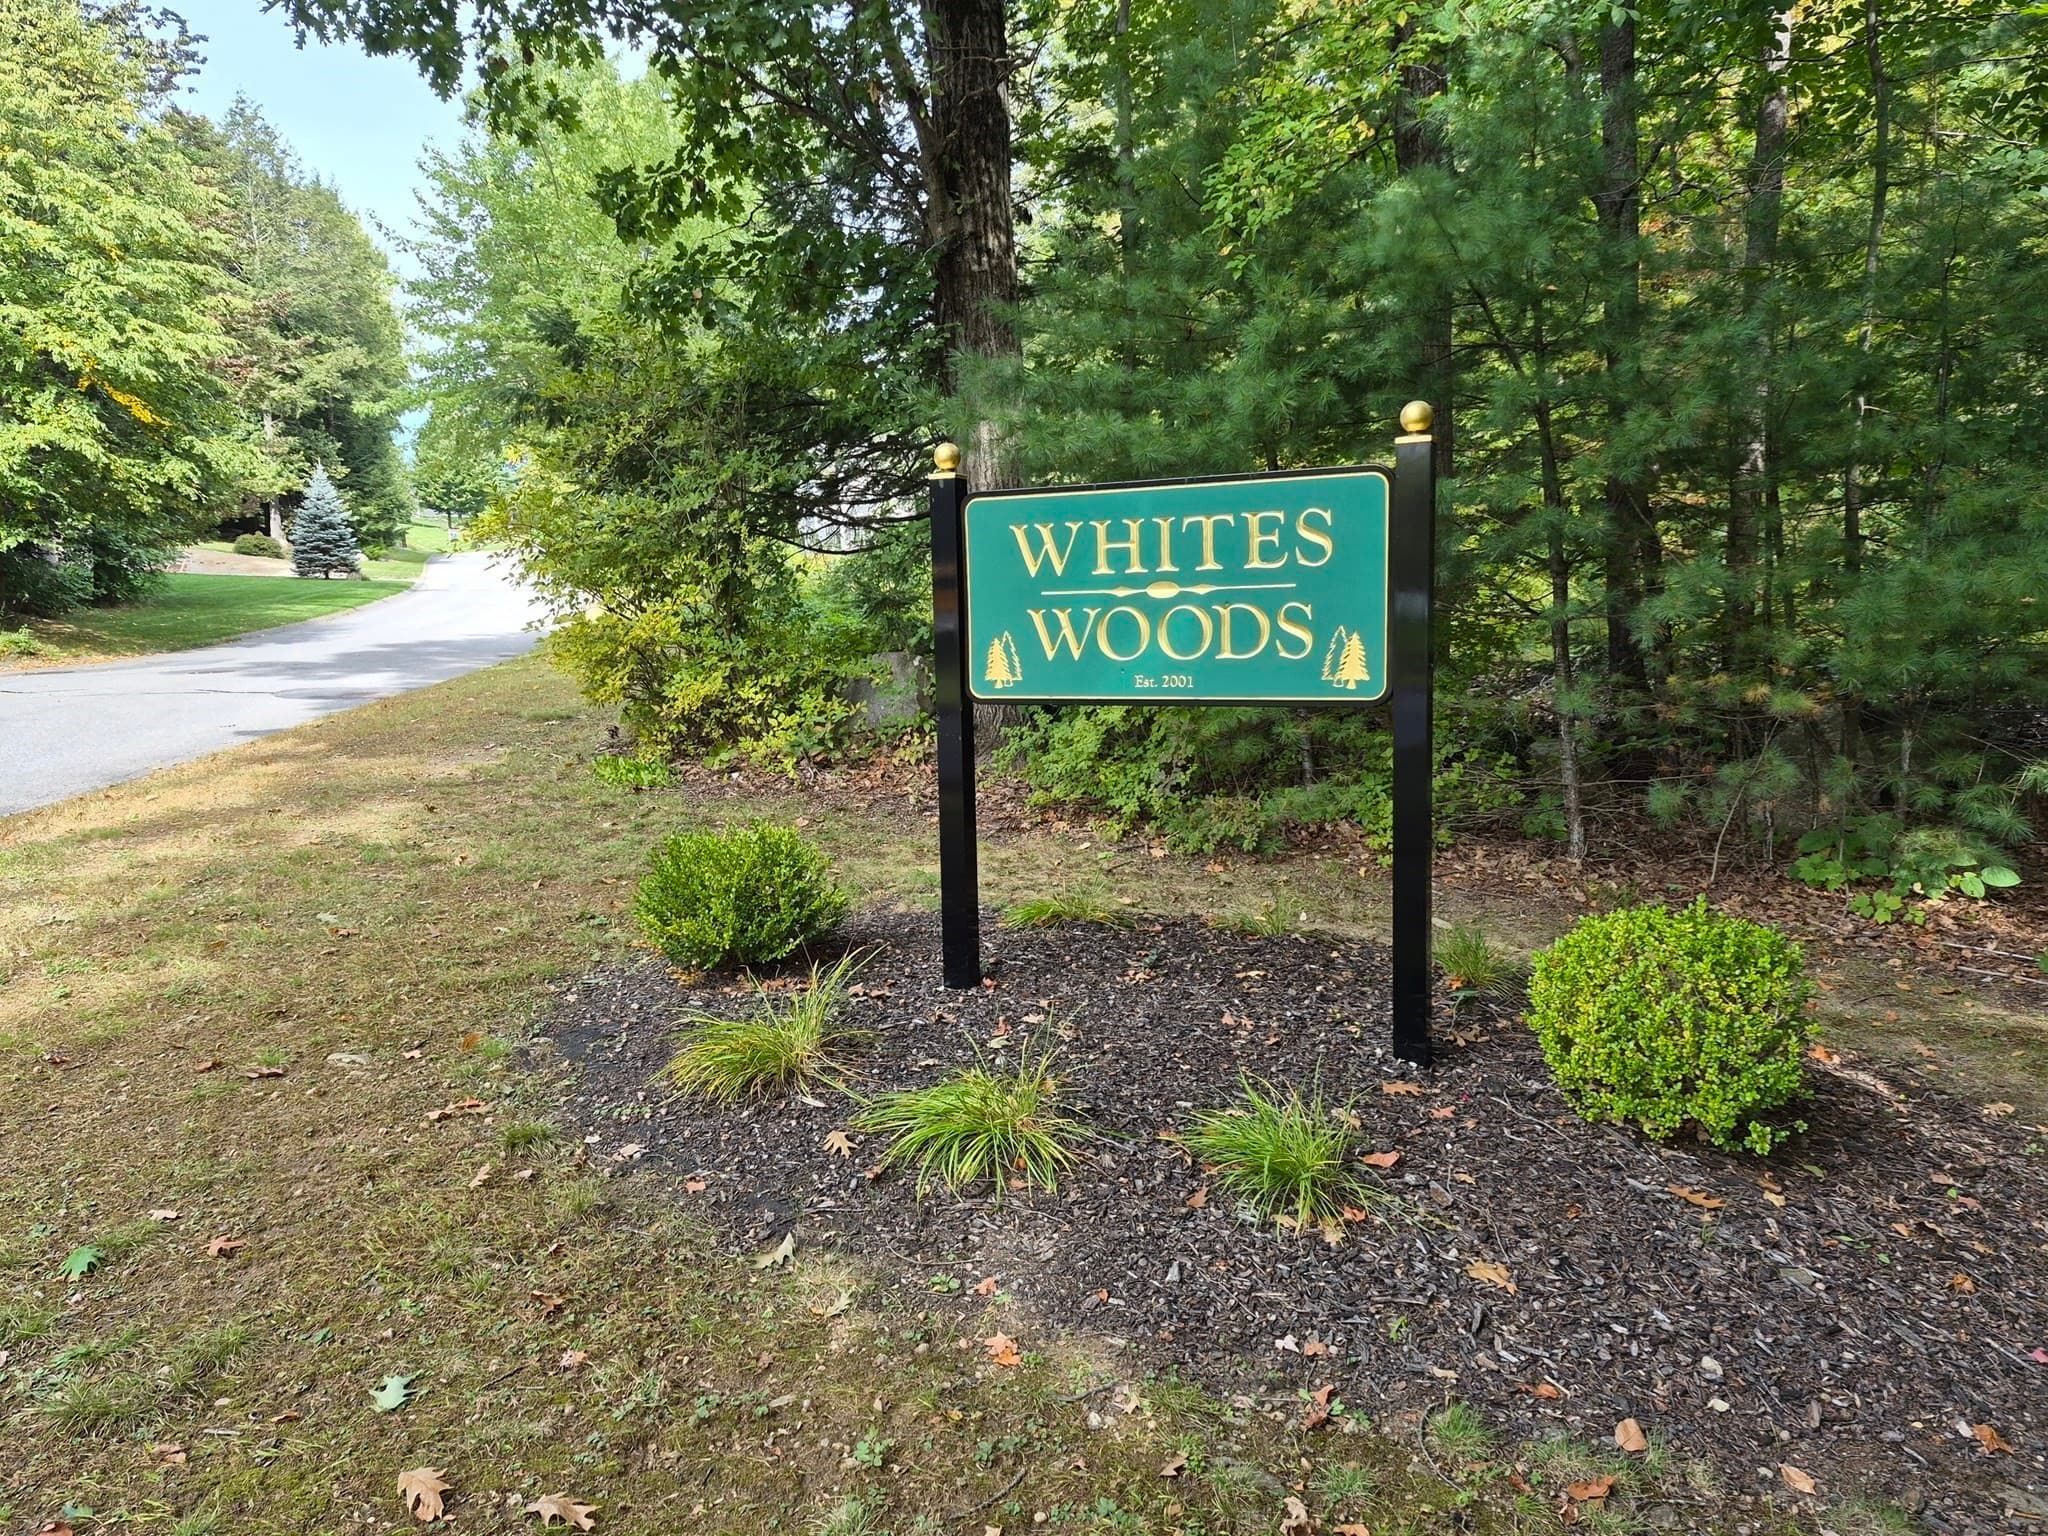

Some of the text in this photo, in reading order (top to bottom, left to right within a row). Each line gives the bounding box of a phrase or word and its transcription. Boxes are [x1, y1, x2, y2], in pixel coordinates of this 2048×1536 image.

[1010, 508, 1333, 577] WHITES
[1027, 602, 1314, 662] WOODS
[1134, 674, 1194, 688] Est. 2001
